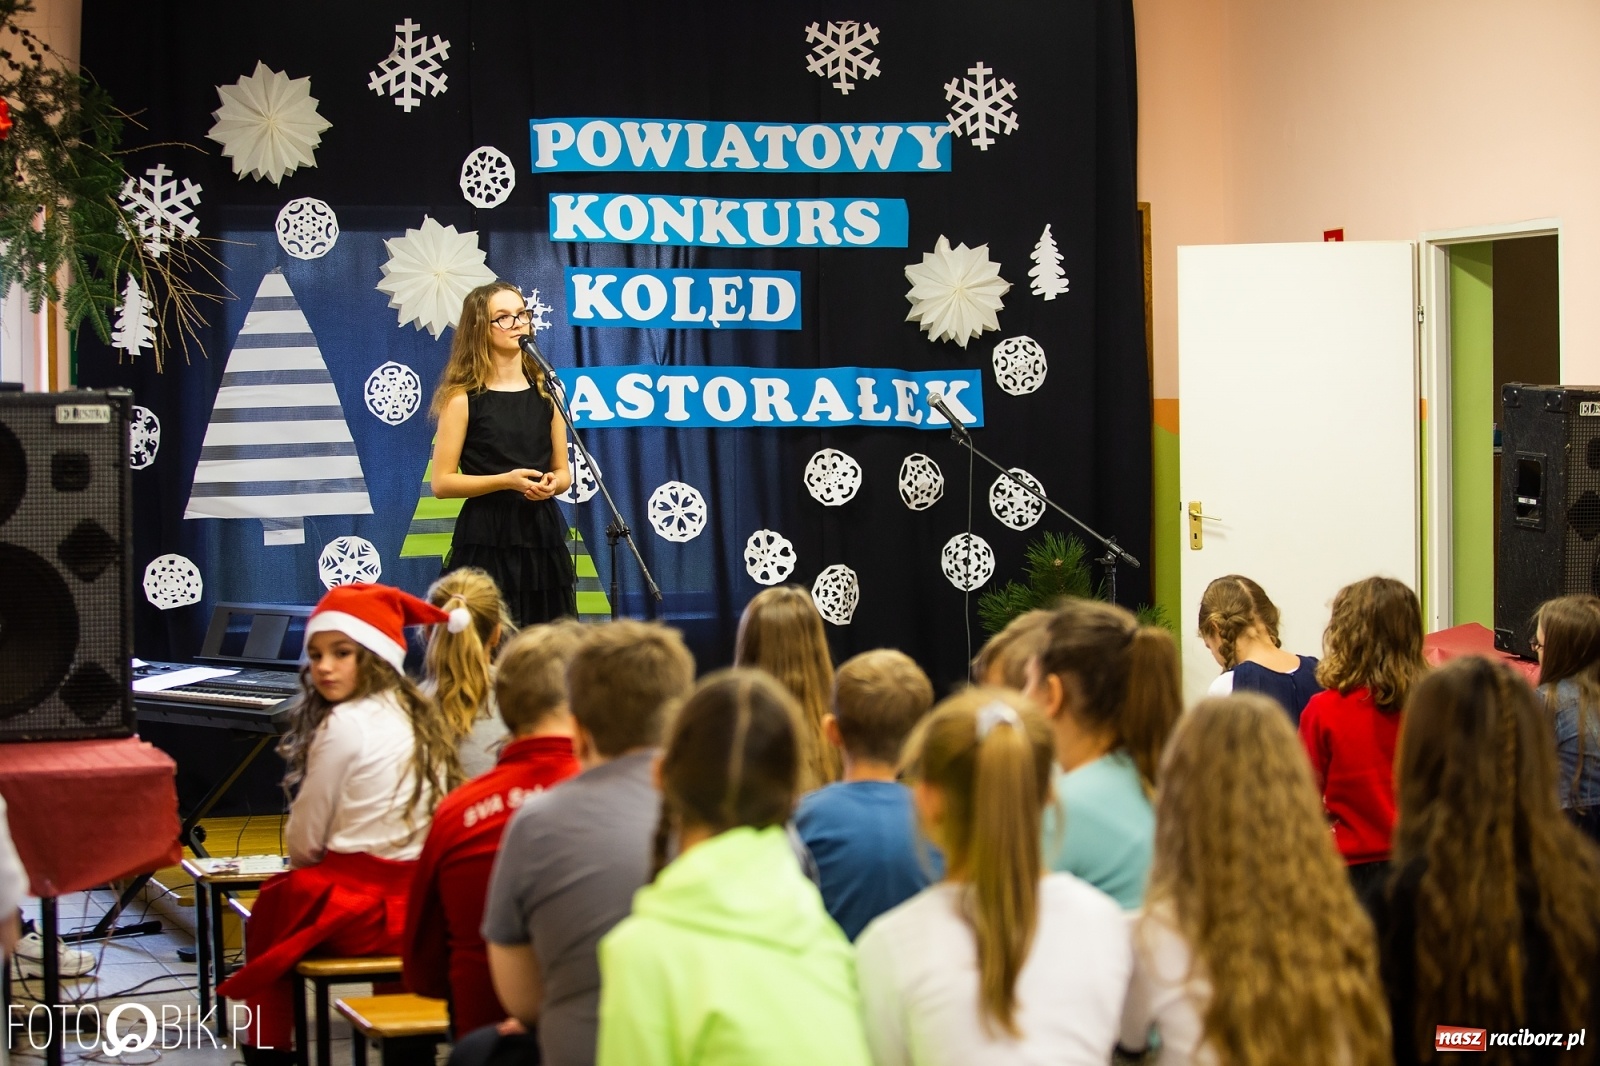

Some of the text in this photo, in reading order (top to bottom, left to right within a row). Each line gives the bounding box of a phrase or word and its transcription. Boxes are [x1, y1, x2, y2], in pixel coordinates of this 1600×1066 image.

[532, 120, 952, 170] POWIATOWY
[551, 194, 881, 246] KONKURS
[571, 272, 797, 328] KOLĘD
[552, 373, 977, 425] ASTORAŁEK
